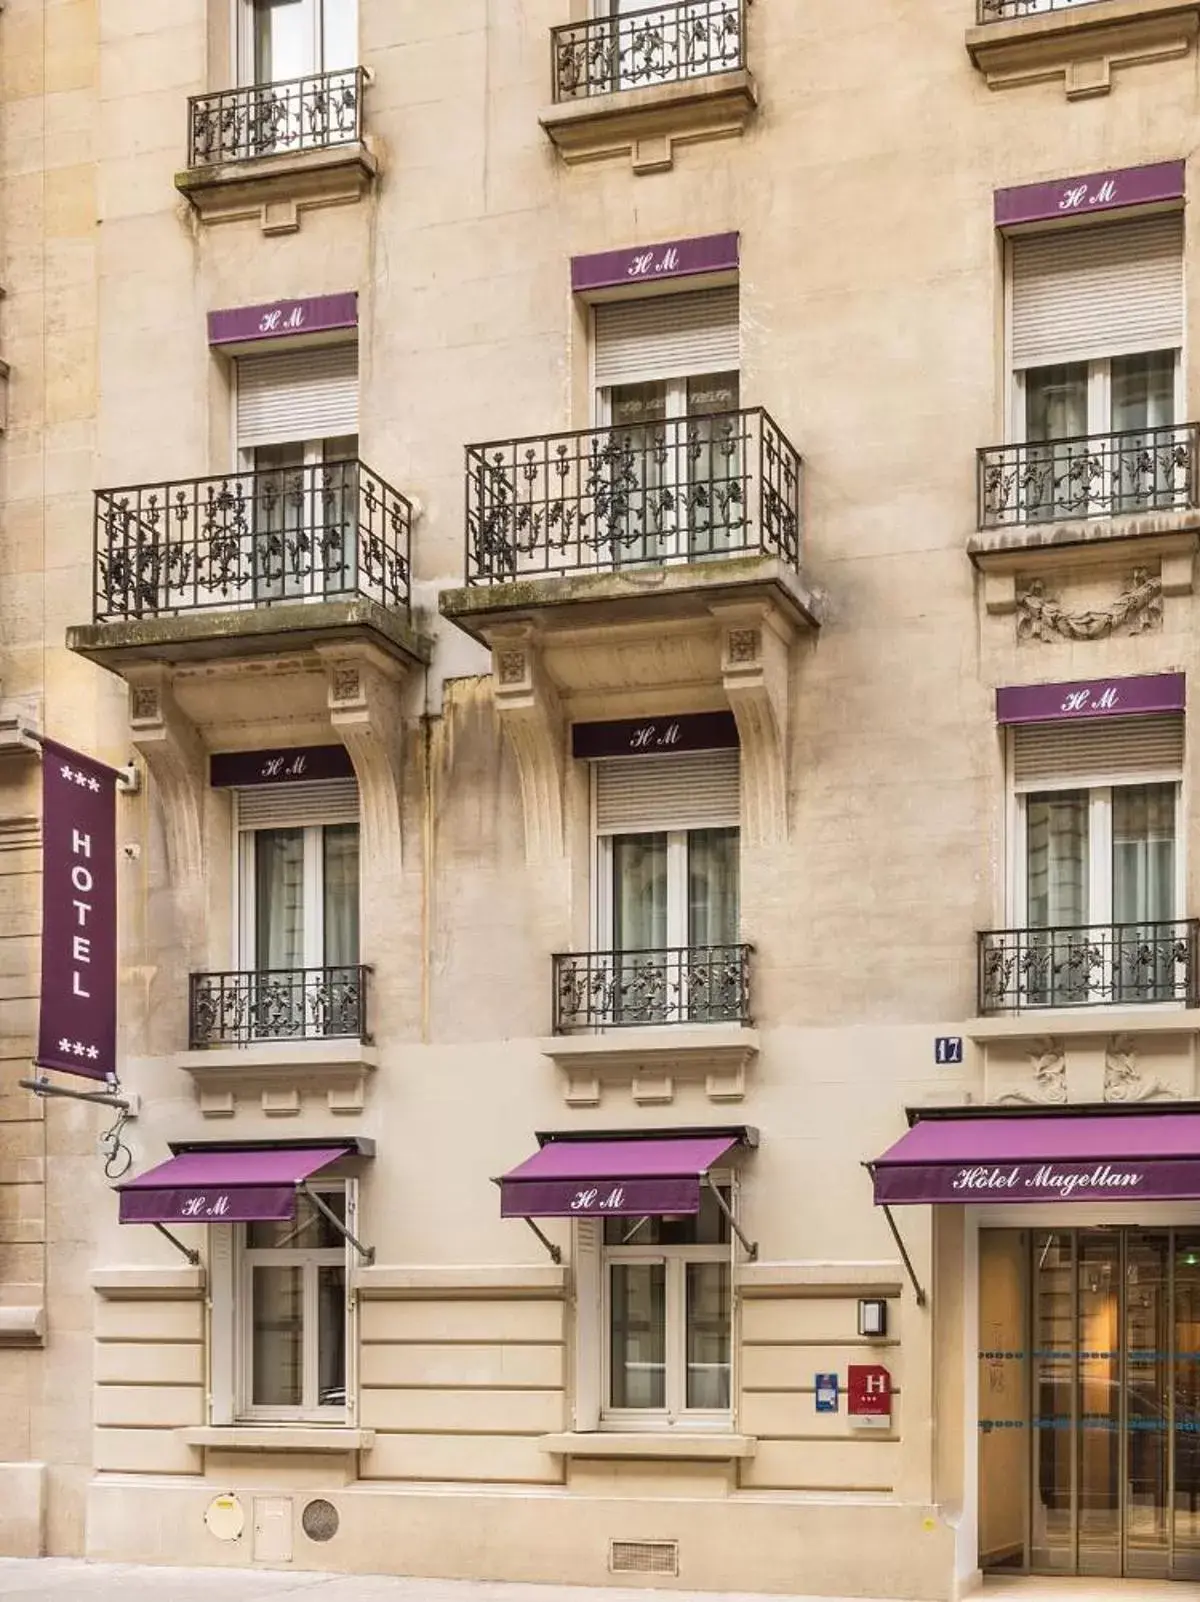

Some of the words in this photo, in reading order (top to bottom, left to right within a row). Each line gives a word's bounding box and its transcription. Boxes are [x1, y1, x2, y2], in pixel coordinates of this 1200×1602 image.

[1059, 185, 1088, 209] H
[1090, 180, 1117, 204] M
[627, 252, 654, 276] H
[655, 248, 679, 271] M
[259, 310, 282, 331] H
[284, 307, 305, 328] M
[1061, 689, 1090, 711] H
[1092, 687, 1119, 709] M
[629, 726, 655, 748] H
[657, 724, 680, 745] M
[262, 757, 284, 776] H
[285, 755, 306, 774] M
[71, 829, 92, 998] HOTEL
[938, 1040, 959, 1061] 17
[953, 1165, 1019, 1189] Hôtel
[1024, 1164, 1143, 1197] Magellan
[181, 1196, 206, 1216] H
[207, 1196, 230, 1216] M
[570, 1188, 598, 1209] H
[600, 1188, 624, 1208] M
[866, 1374, 886, 1393] H
